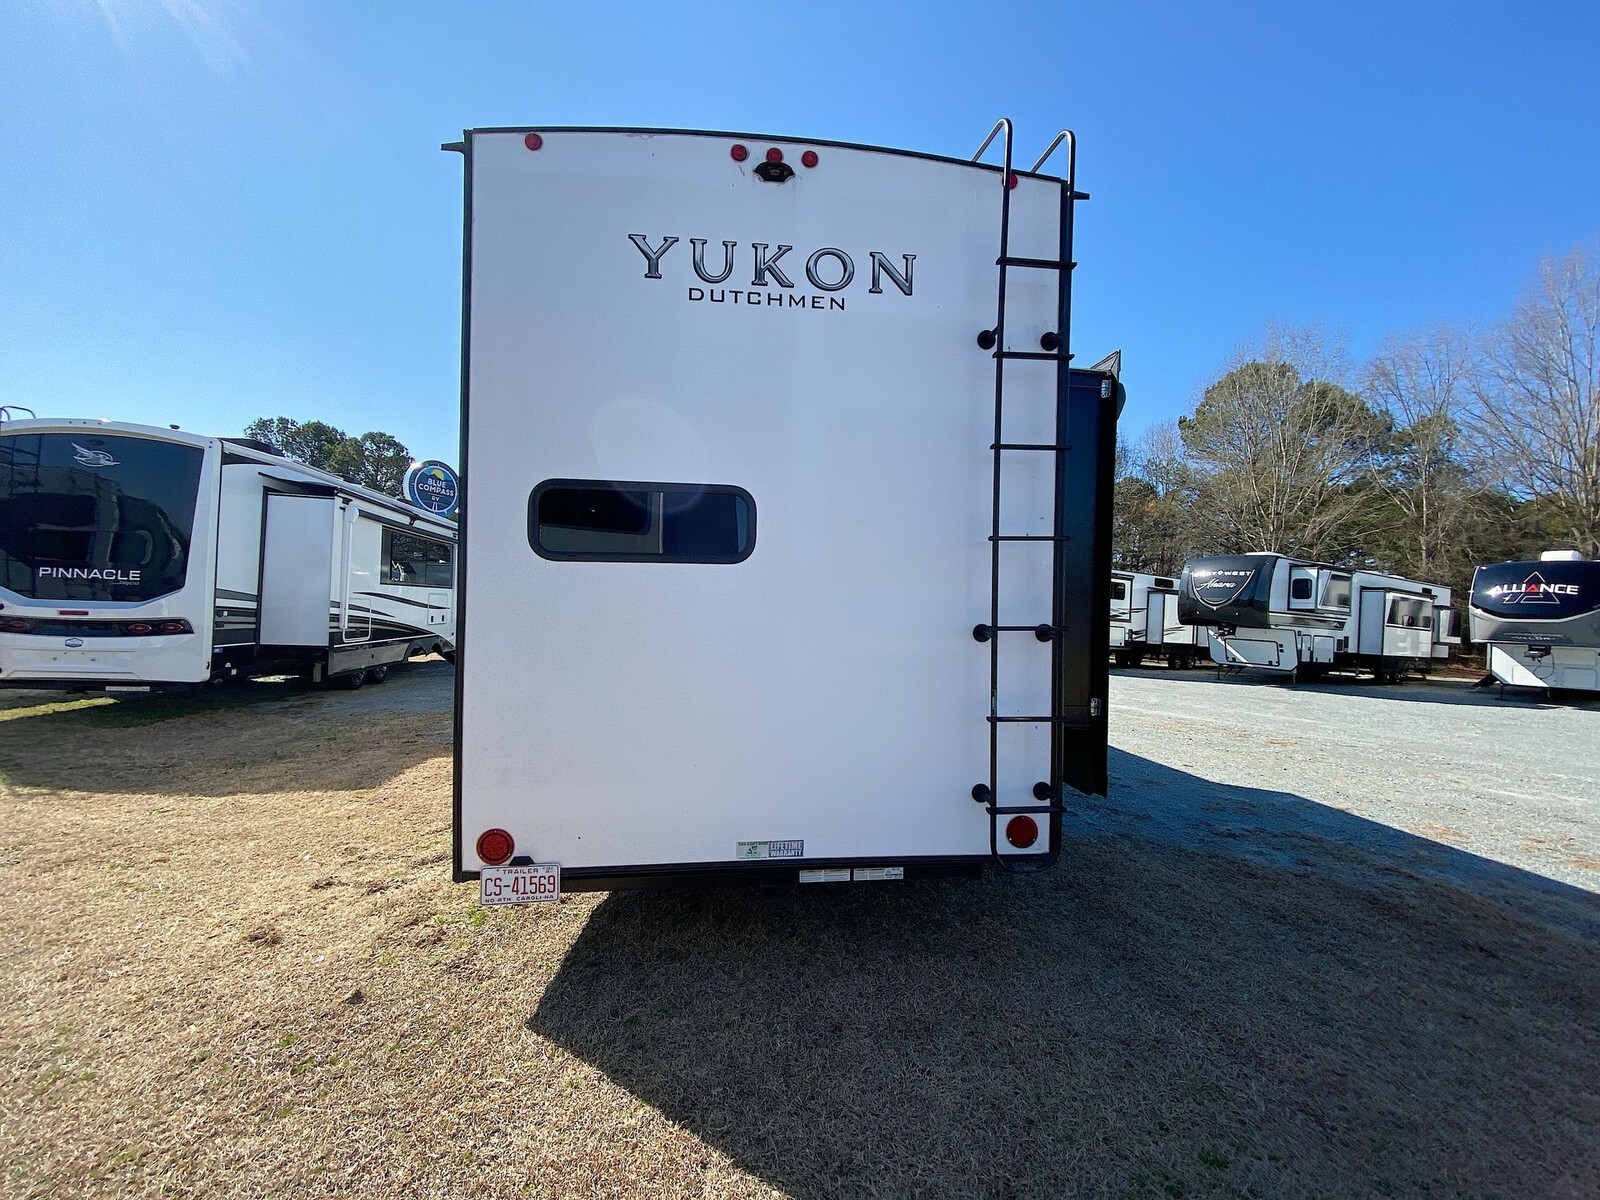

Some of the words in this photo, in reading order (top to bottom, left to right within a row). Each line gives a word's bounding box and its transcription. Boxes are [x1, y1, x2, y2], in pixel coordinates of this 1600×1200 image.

[628, 234, 916, 296] YUKON
[688, 287, 846, 311] DUTCHMEN
[418, 483, 454, 497] COMPASS
[428, 478, 447, 488] BLUE
[39, 567, 141, 581] PINNACLE
[1487, 583, 1579, 595] ALLIANCE
[770, 841, 802, 850] LIFETIME
[484, 875, 556, 897] CS-41569
